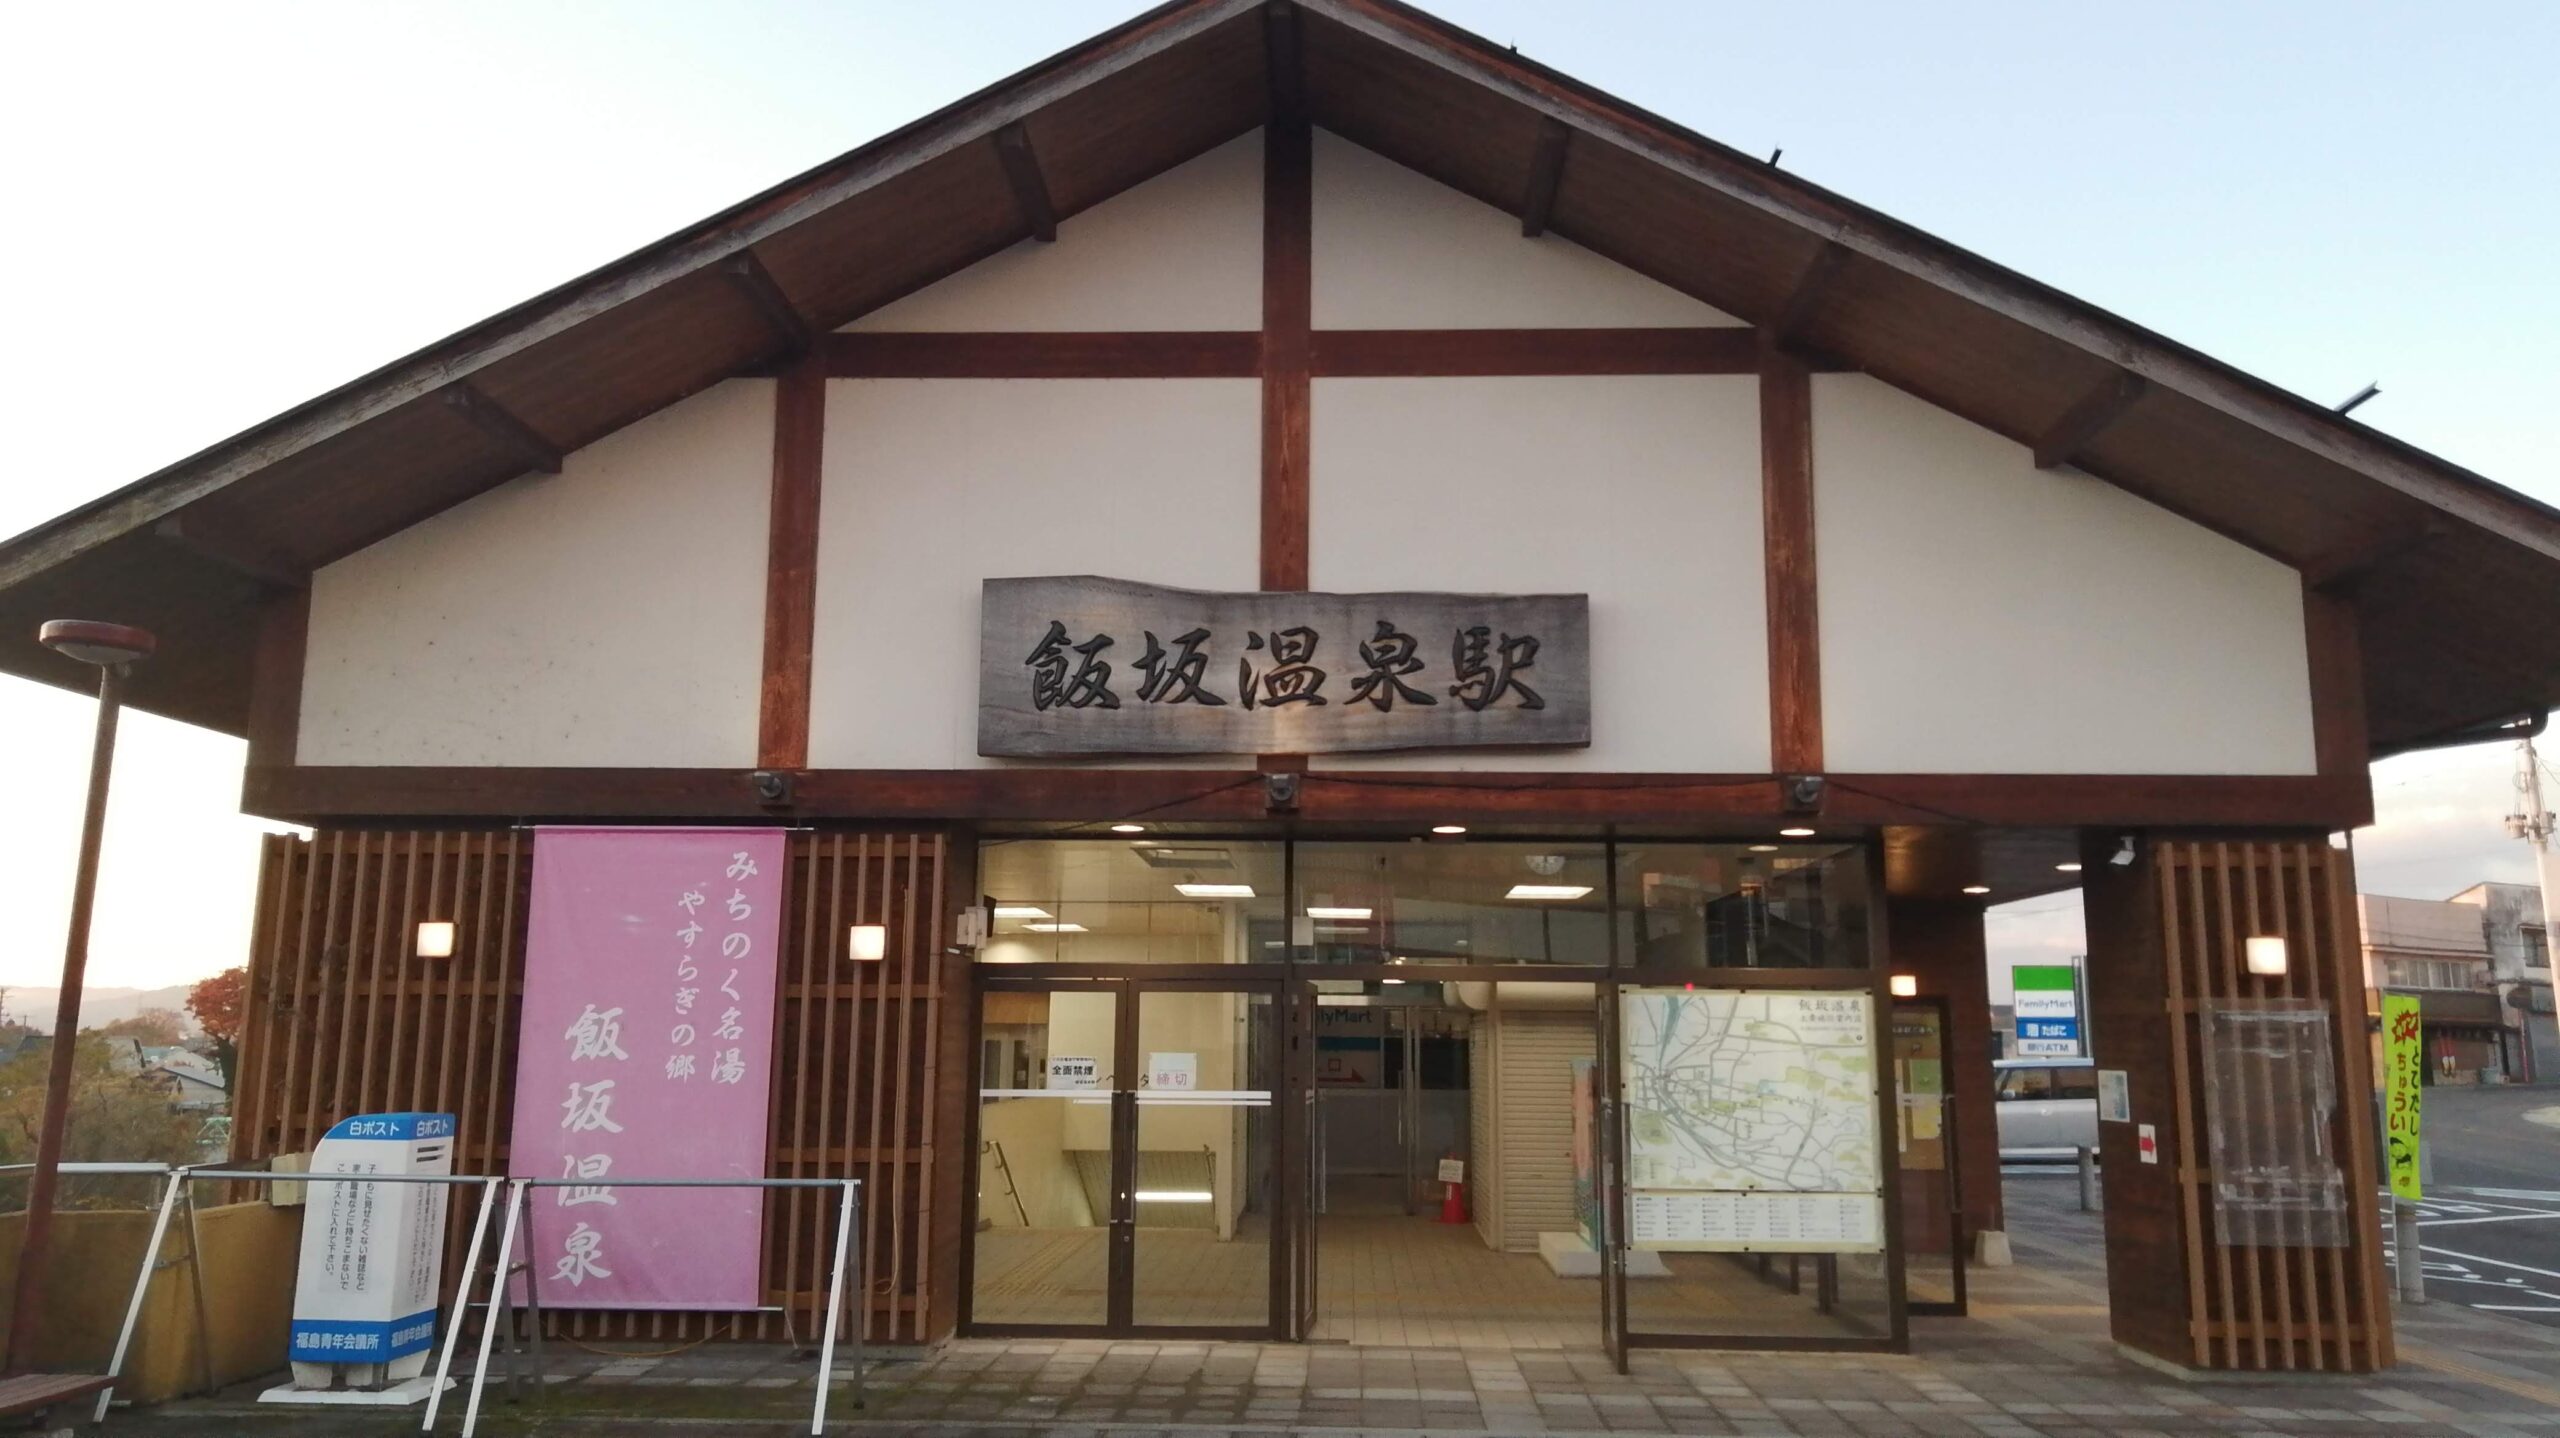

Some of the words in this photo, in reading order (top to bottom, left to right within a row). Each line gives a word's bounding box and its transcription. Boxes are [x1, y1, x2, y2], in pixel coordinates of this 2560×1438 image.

[1024, 619, 1546, 713] 飯坂温泉駅
[711, 850, 758, 1085] みちのく名湯
[664, 886, 706, 1083] やすらぎの郷
[2018, 999, 2073, 1010] FamilyMart
[2042, 1024, 2067, 1036] たばこ
[1052, 1065, 1094, 1076] 全面禁煙
[1156, 1073, 1188, 1086] 締切
[2390, 1052, 2408, 1131] ちゅうい
[350, 1121, 400, 1136] 白ポスト
[416, 1119, 448, 1137] 白ポスト
[549, 1003, 629, 1287] 飯坂温泉
[356, 1163, 376, 1291] 子もに見せたくない雑誌など
[296, 1332, 379, 1350] 福島青年会議所
